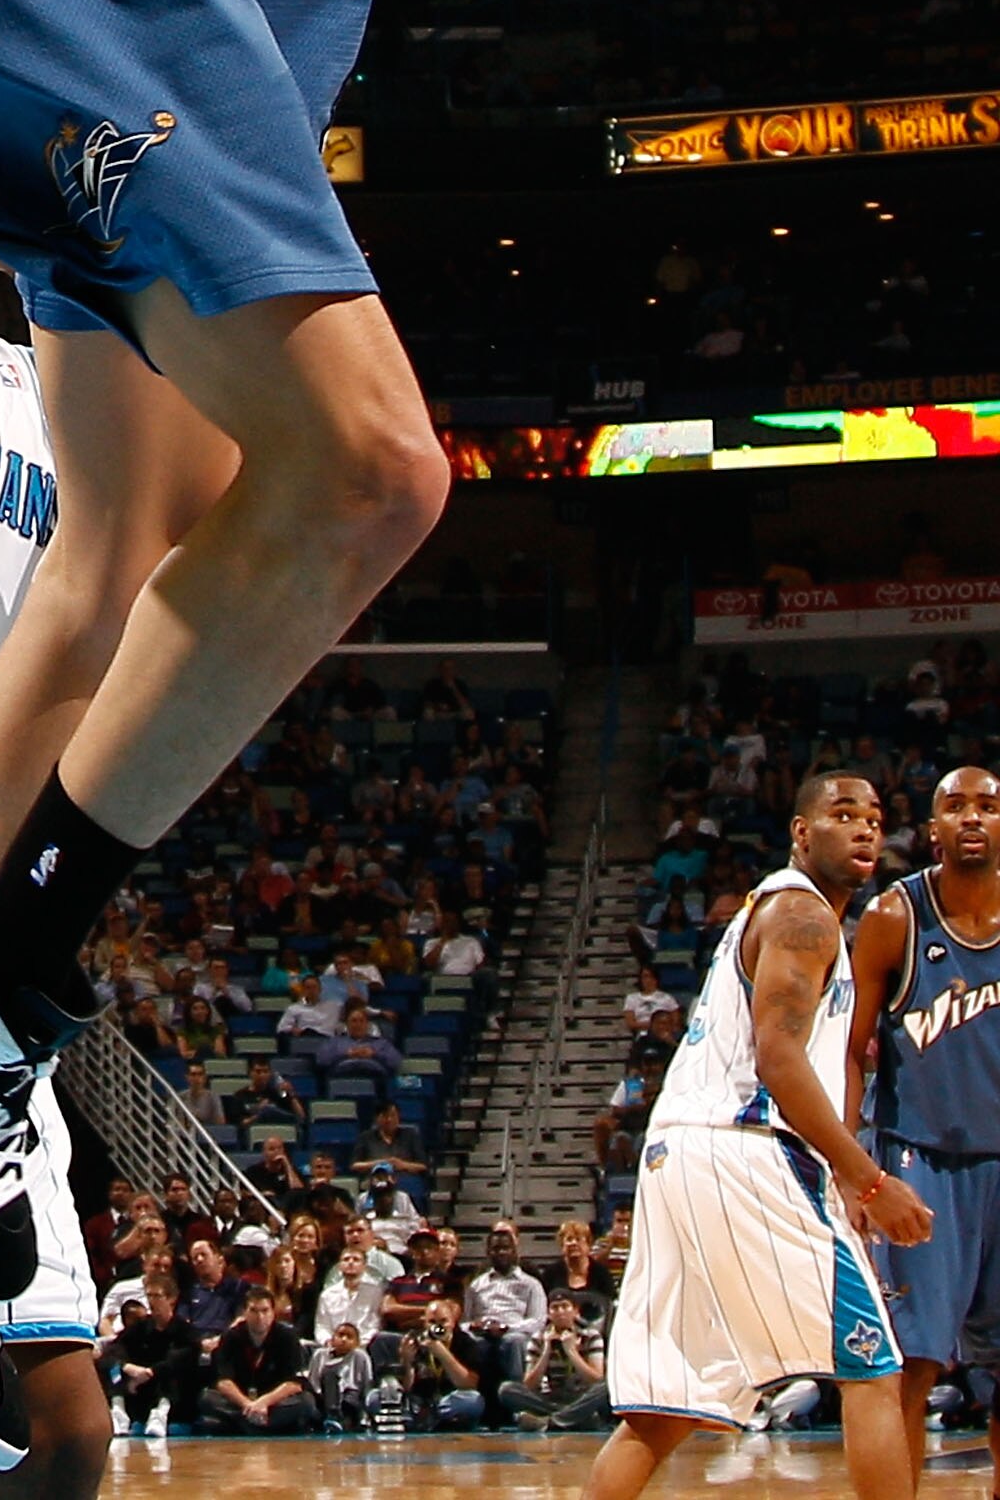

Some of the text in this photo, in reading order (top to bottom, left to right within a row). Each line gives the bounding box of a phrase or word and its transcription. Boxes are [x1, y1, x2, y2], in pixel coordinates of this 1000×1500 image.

[639, 103, 854, 159] SONIC YOUR
[880, 112, 969, 151] DRINK
[594, 380, 645, 401] HUB
[784, 377, 925, 407] EMPLOYEE
[748, 589, 839, 612] TYOTA
[910, 607, 971, 623] ZONE
